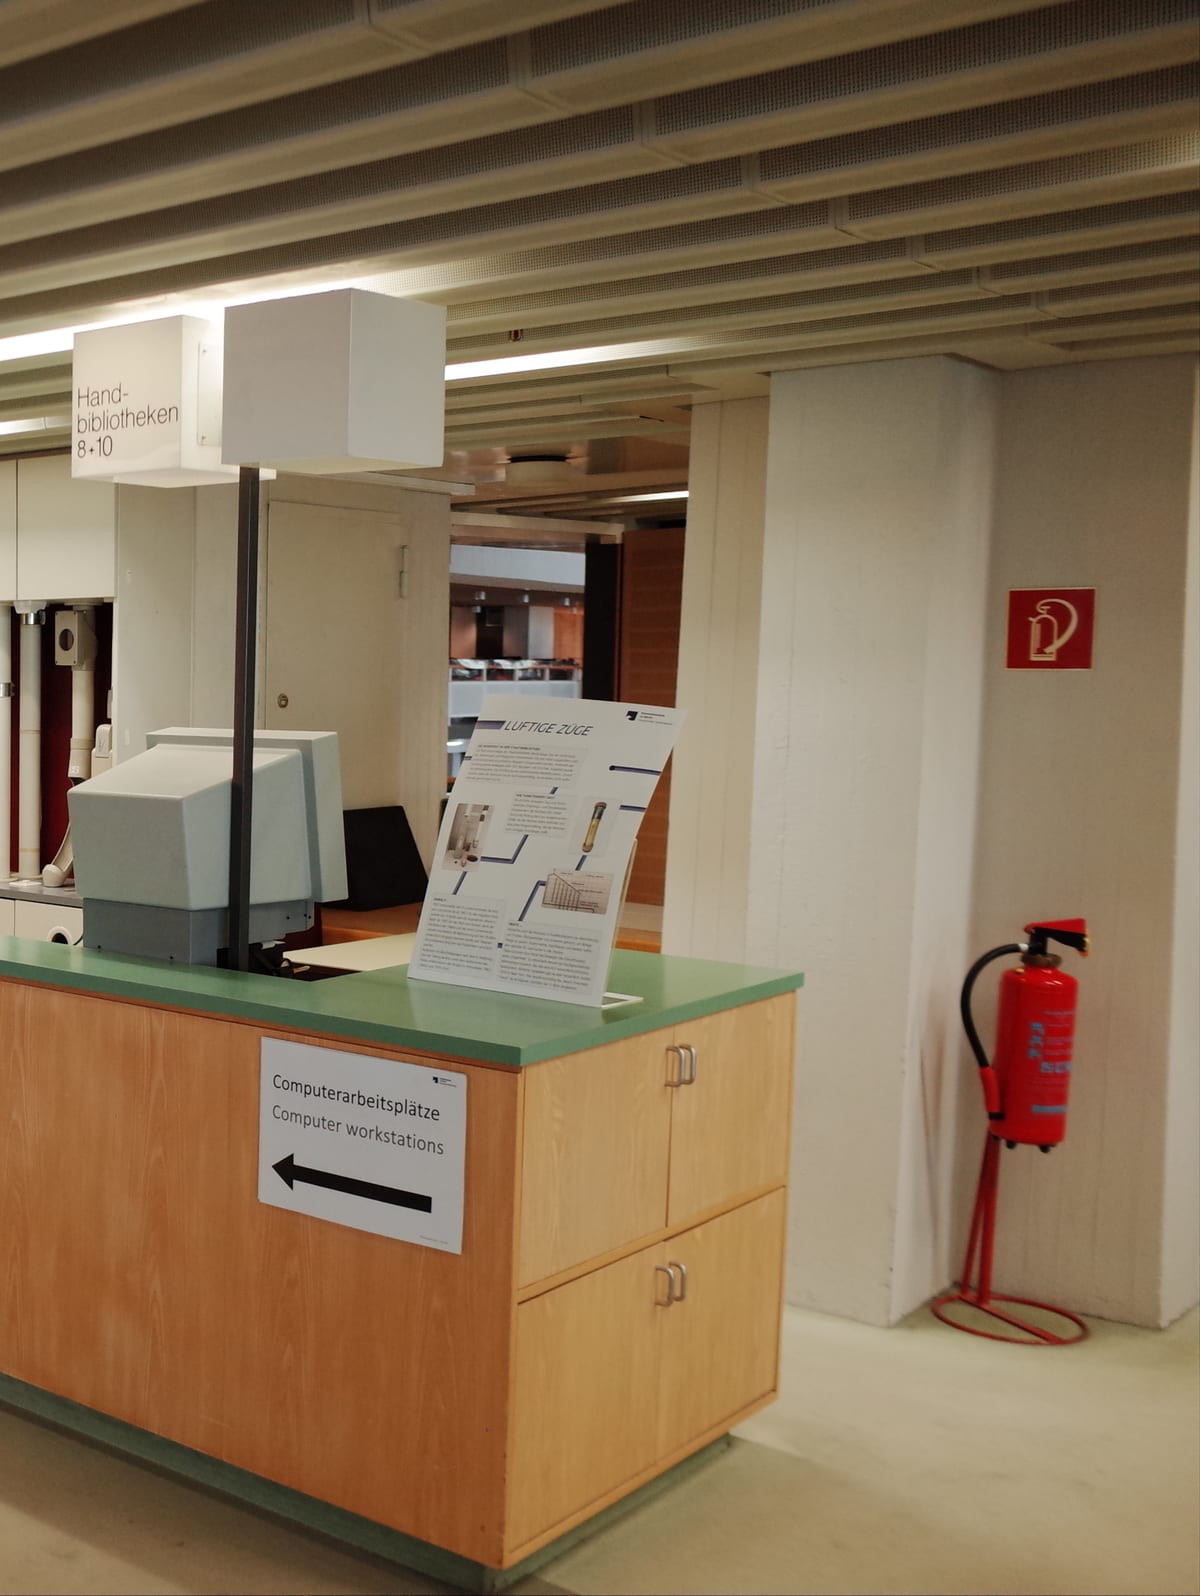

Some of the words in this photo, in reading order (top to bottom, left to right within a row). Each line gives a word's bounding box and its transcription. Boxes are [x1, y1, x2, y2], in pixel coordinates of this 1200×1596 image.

[77, 382, 129, 409] Hand-
[77, 403, 179, 434] bibliotheken
[504, 720, 557, 734] LUFTIGE
[556, 723, 594, 736] ZÜGE
[272, 1074, 441, 1121] Computerarbeitsplätze
[272, 1104, 342, 1132] Computer
[346, 1123, 445, 1155] workstations
